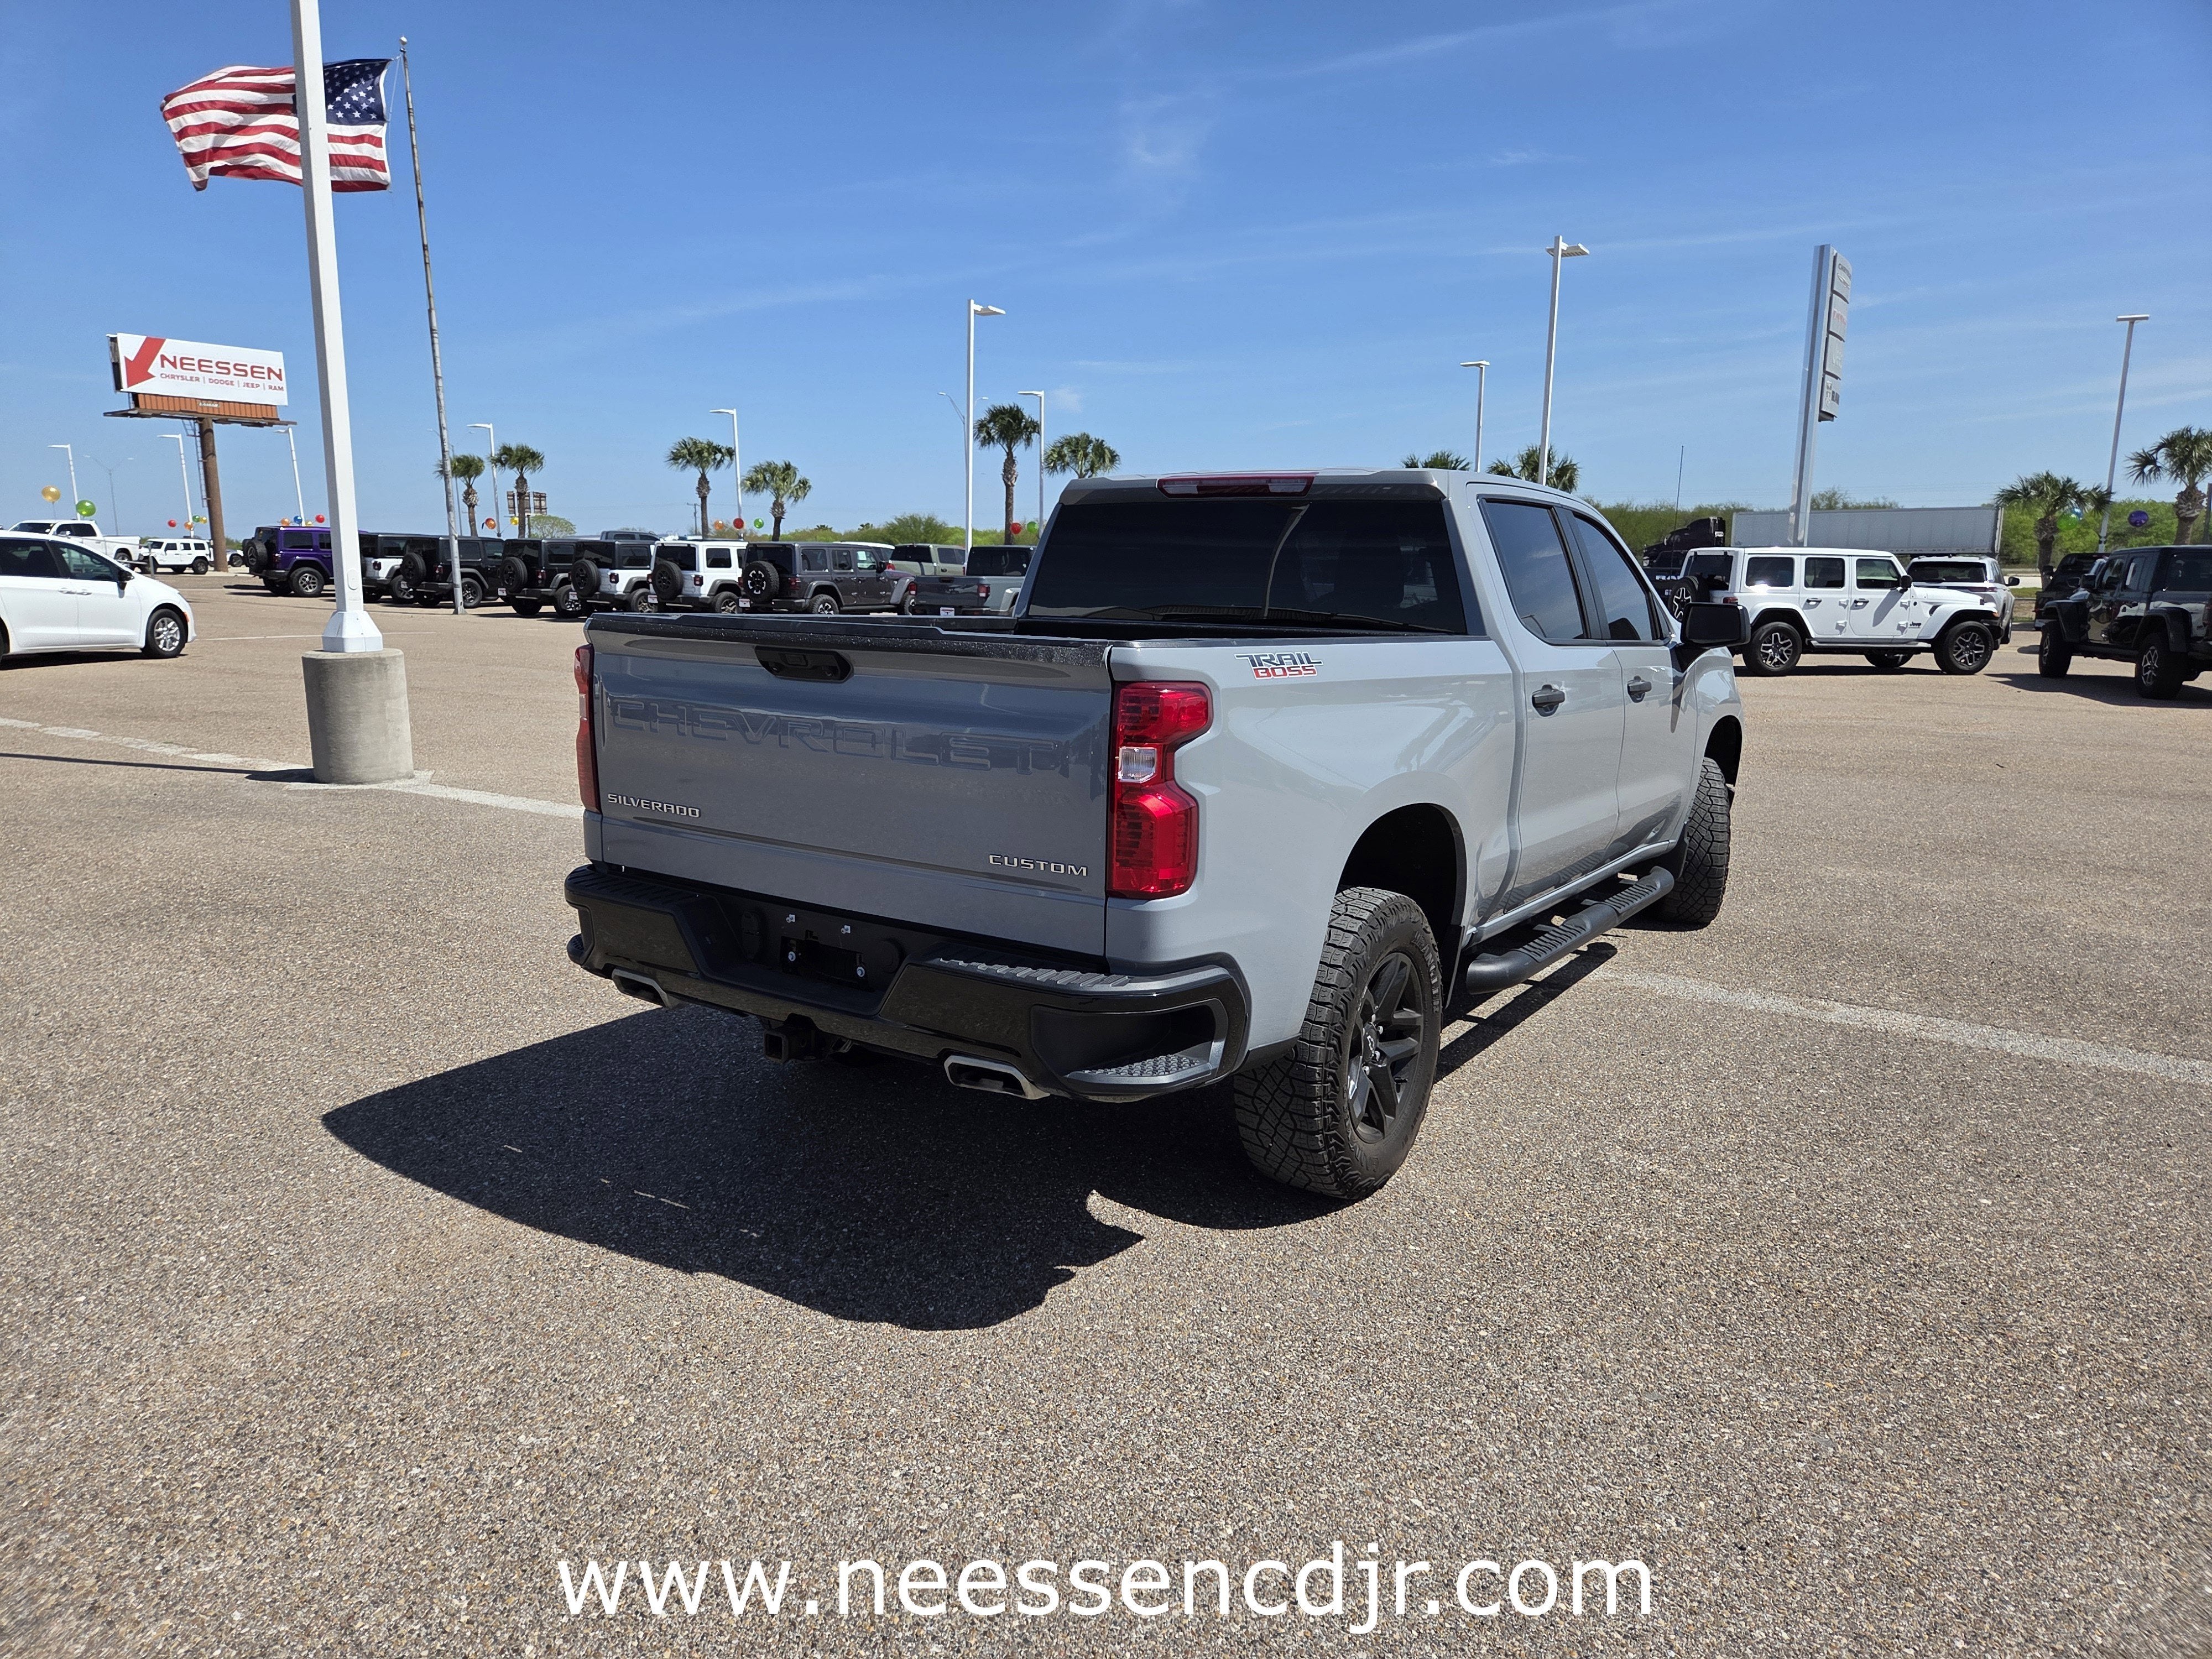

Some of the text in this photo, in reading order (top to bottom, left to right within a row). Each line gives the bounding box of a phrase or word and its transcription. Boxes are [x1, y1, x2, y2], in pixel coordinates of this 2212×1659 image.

[160, 354, 283, 382] NEESSEN
[160, 373, 200, 382] CHRYSLER
[208, 378, 234, 386] DODGE
[1235, 652, 1323, 667] TRAIL
[1253, 665, 1317, 679] BOSS
[612, 698, 1054, 775] CHEVROLET
[608, 794, 700, 818] SILVERADO
[989, 854, 1087, 877] CUSTOM
